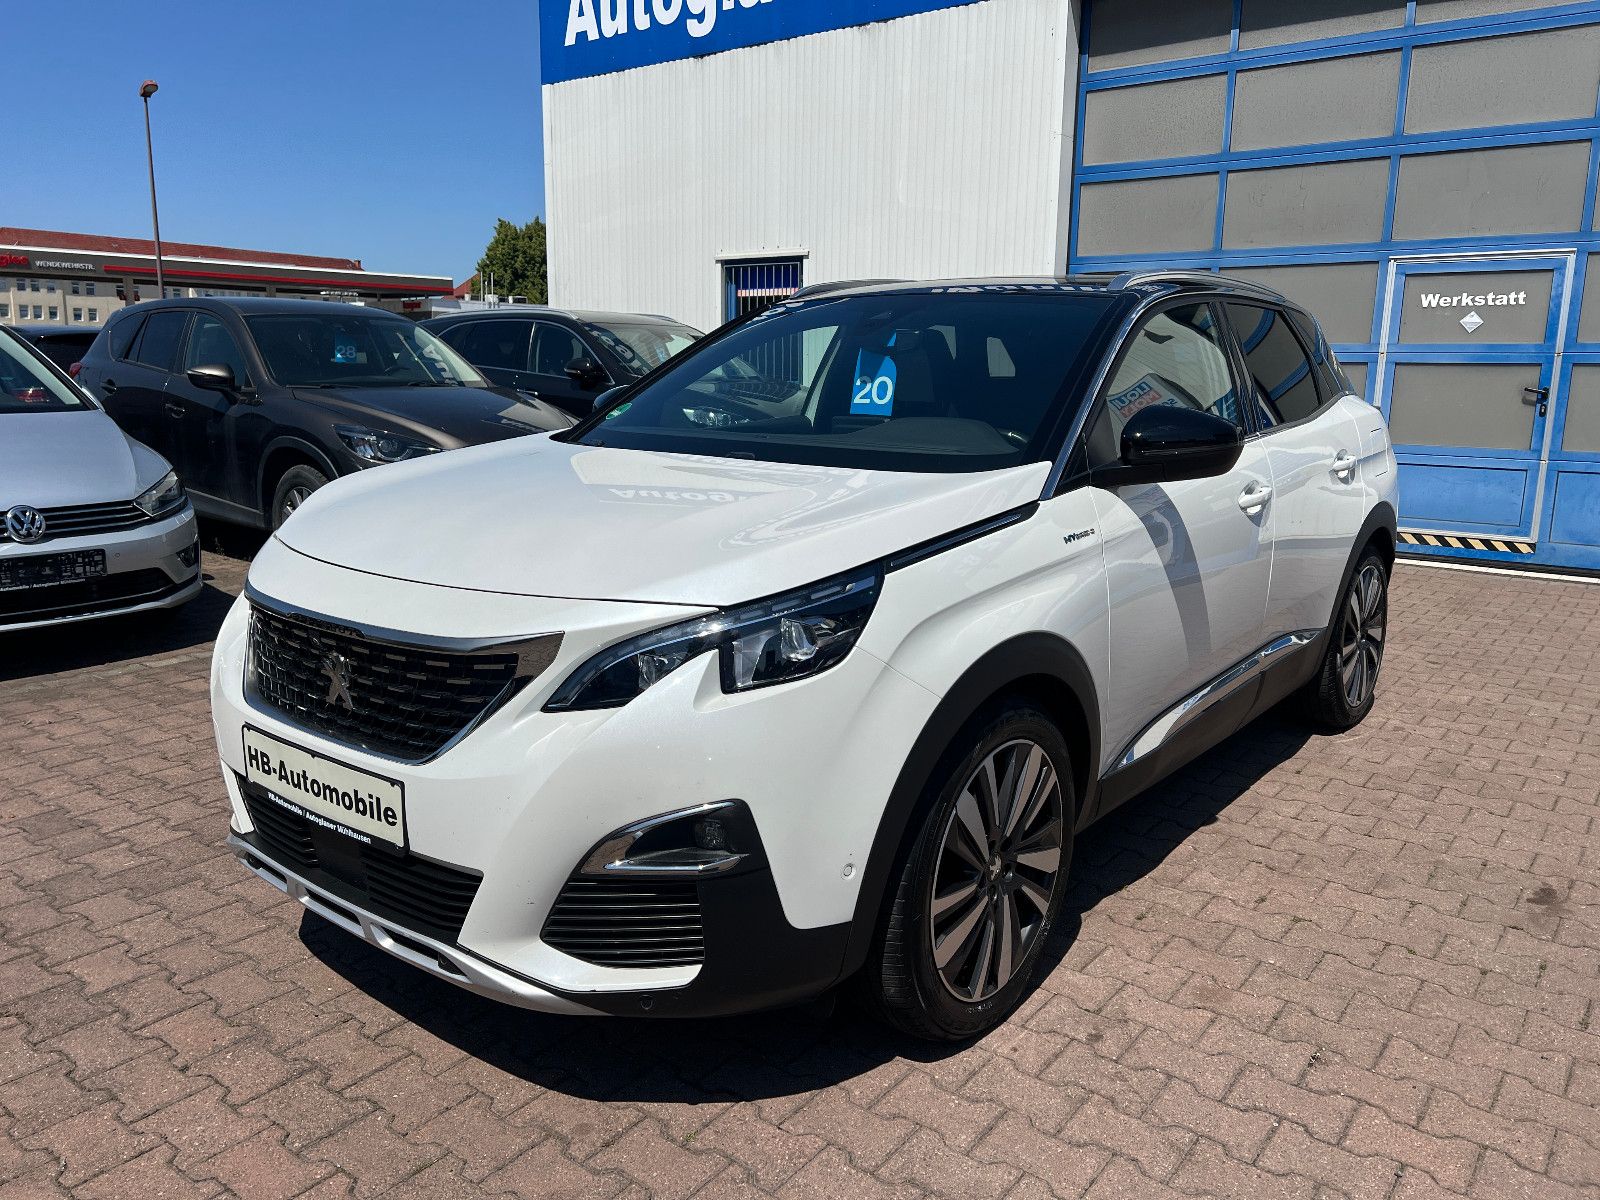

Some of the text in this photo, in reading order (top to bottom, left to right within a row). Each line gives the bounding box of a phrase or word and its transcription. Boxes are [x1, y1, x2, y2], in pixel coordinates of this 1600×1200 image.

[564, 0, 773, 47] Autog
[1421, 291, 1527, 308] Werkstatt
[336, 345, 356, 358] 28
[854, 376, 893, 405] 20
[247, 745, 398, 827] HB-Automobile
